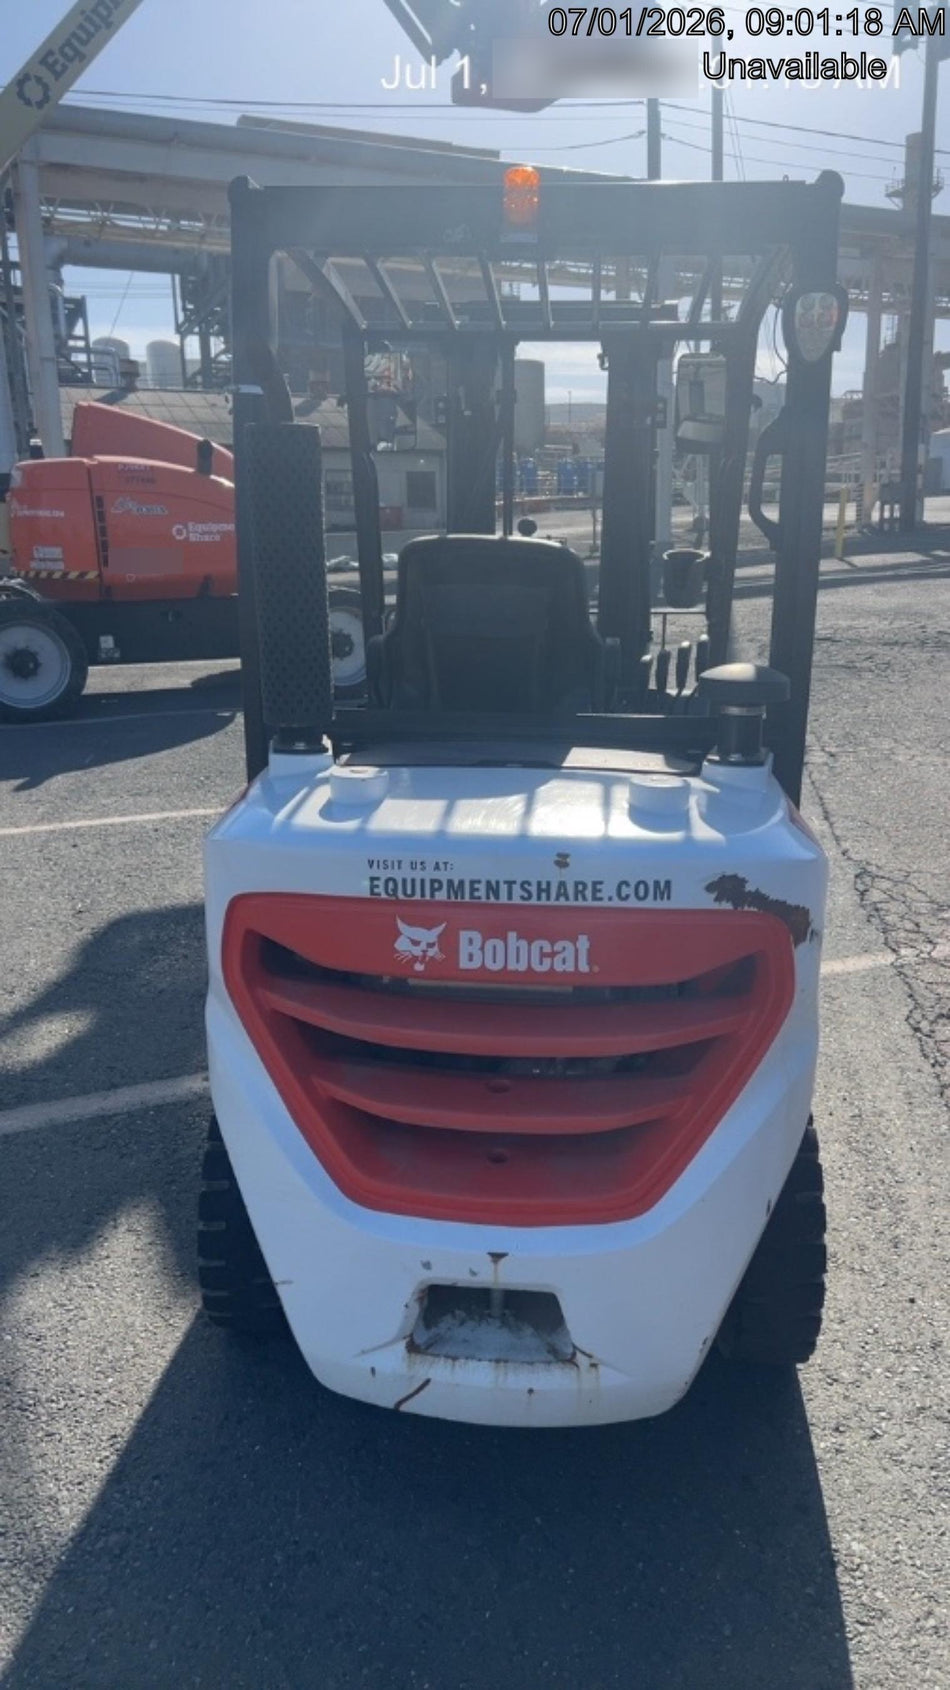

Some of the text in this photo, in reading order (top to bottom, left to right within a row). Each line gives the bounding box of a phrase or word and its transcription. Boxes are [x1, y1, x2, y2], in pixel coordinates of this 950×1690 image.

[39, 0, 123, 81] Equip
[367, 859, 454, 872] VISIT US AT:
[369, 876, 672, 901] EQUIPMENTSHARE.COM
[459, 930, 592, 973] Bobcat
